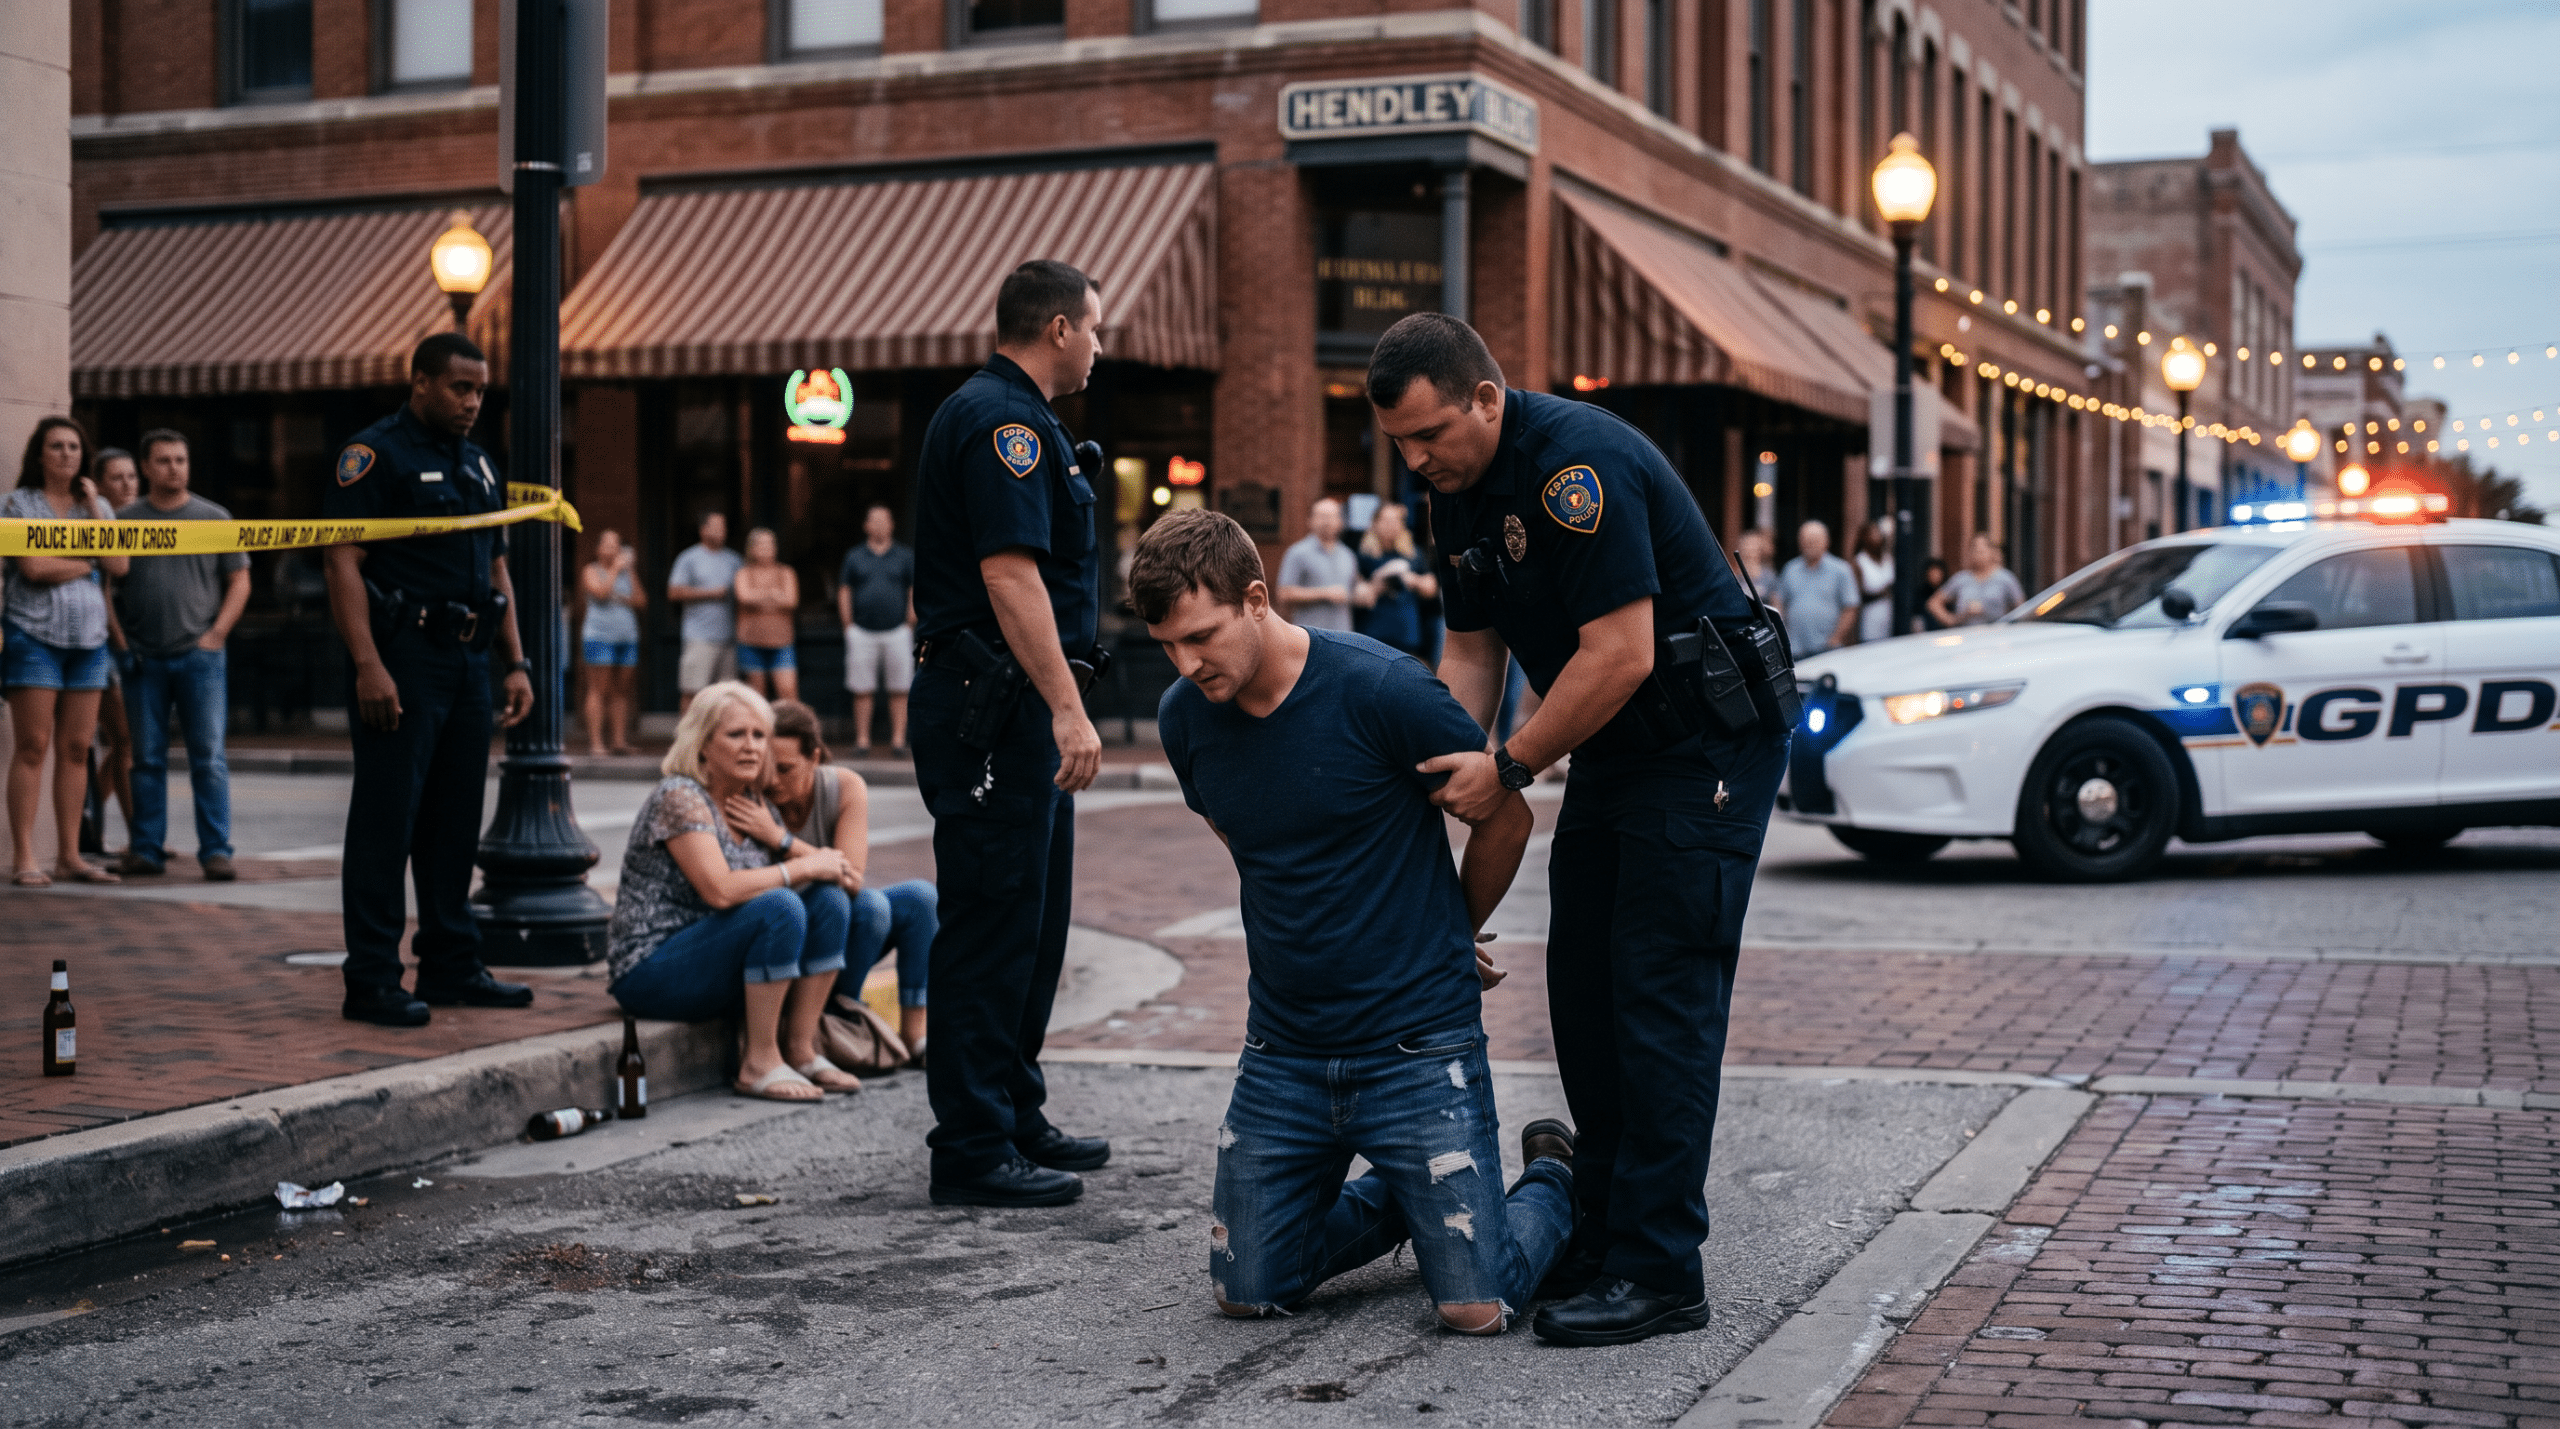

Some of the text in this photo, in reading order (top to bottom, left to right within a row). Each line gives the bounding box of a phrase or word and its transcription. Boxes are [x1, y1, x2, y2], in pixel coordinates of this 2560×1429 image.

[1292, 81, 1478, 127] HENDLEY
[26, 526, 178, 549] POLICE LINE DO NOT CROSS
[236, 526, 274, 547] POLICE
[2295, 679, 2558, 742] GPD
